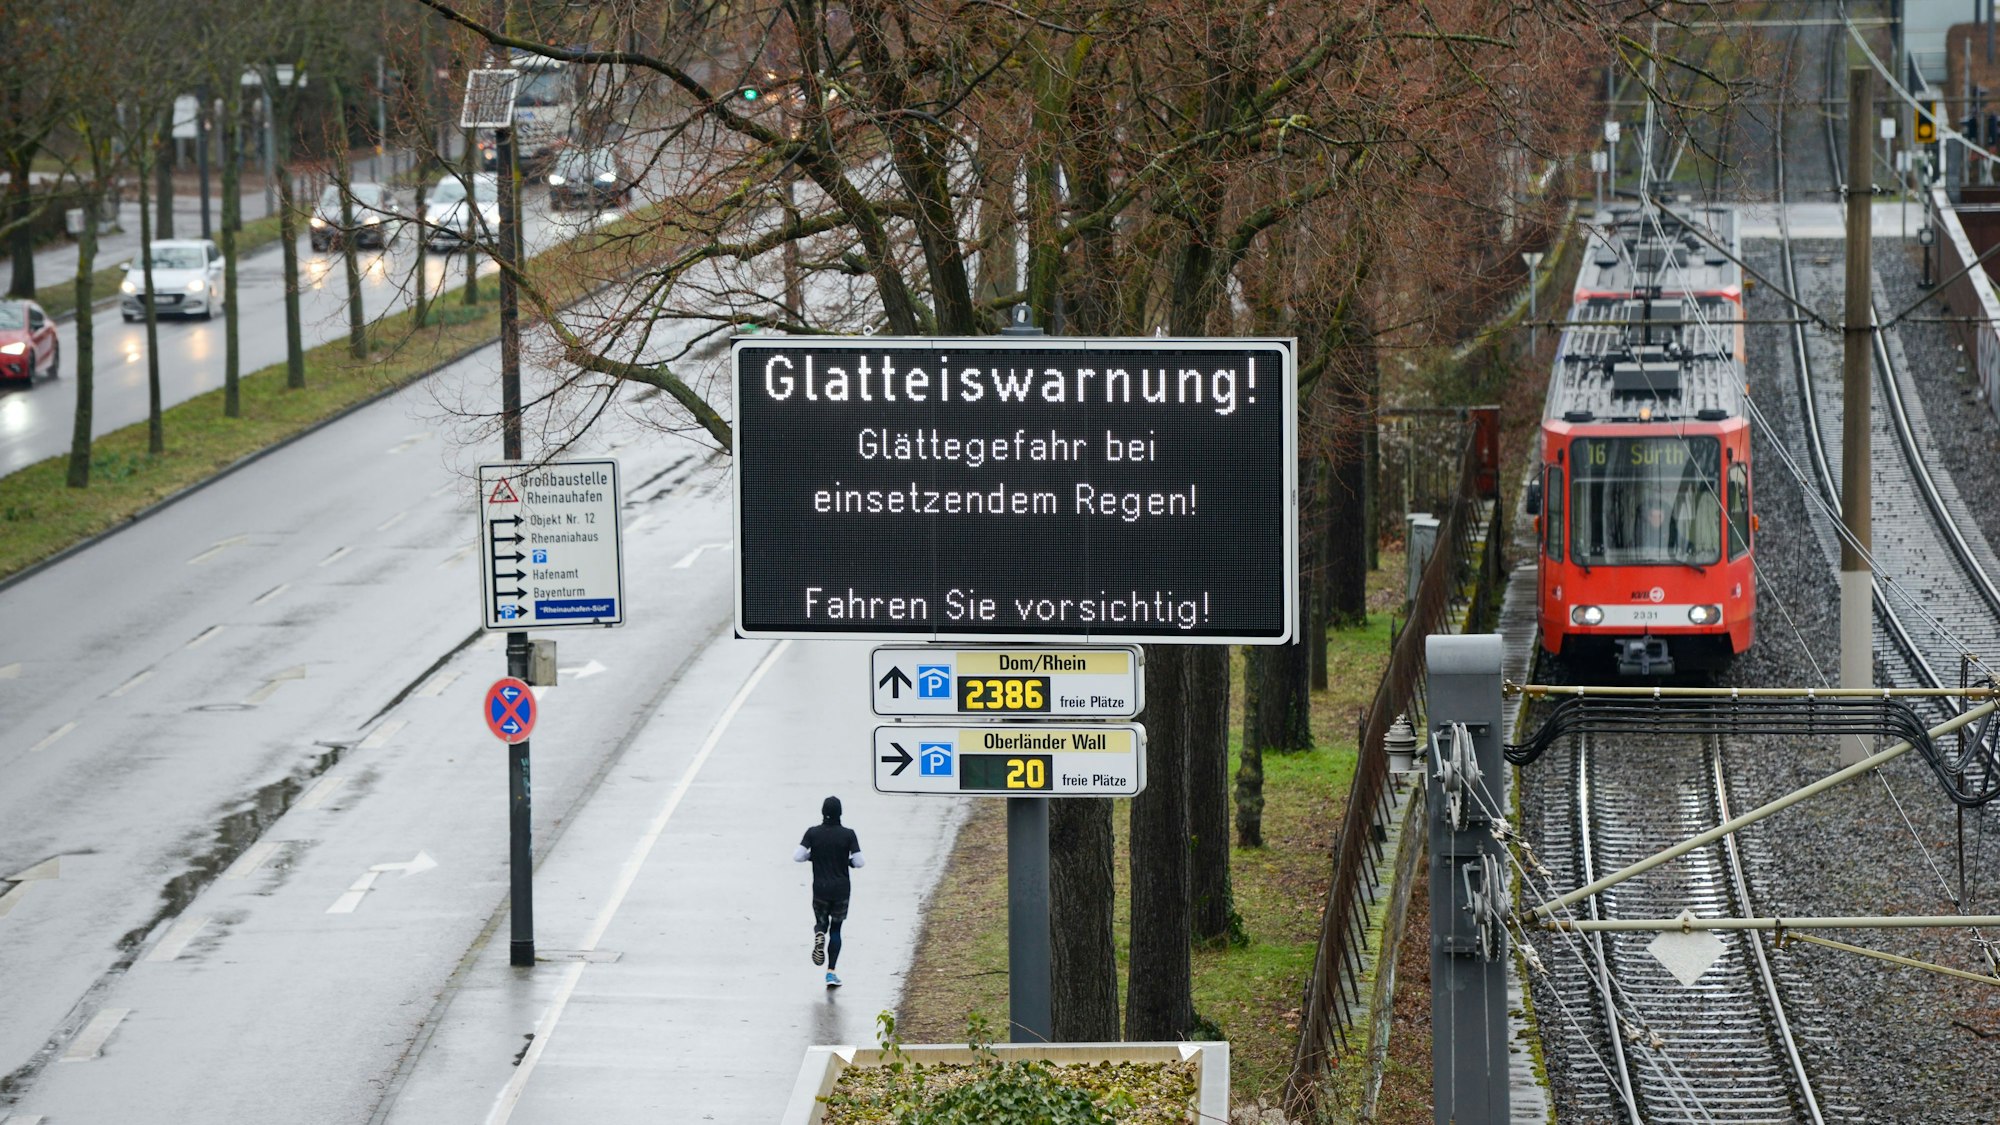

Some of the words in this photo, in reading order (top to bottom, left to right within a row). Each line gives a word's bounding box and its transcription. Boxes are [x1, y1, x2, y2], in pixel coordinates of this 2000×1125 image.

[765, 354, 1257, 416] Glatteiswarnung!
[858, 428, 1087, 467] Glättegefahr
[1106, 430, 1156, 462] bei
[1588, 443, 1606, 465] 16
[520, 471, 608, 488] Großbaustelle
[527, 490, 603, 504] Rheinauhafen
[814, 481, 1057, 515] einsetzendem
[1076, 484, 1197, 523] Regen!
[530, 514, 561, 528] Objekt
[566, 514, 580, 525] Nr.
[585, 513, 596, 524] 12
[531, 532, 599, 544] Rhenaniahaus
[533, 568, 579, 580] Hafenamt
[533, 587, 586, 601] Bayenturm
[806, 587, 927, 621] Fahren
[946, 588, 996, 621] Sie
[1015, 590, 1209, 630] vorsichtig!
[1633, 611, 1658, 620] 2331
[999, 654, 1086, 673] Dom/Rhein
[966, 679, 1043, 709] 2386
[1060, 695, 1086, 708] freie
[1090, 695, 1124, 709] Plätze
[984, 733, 1067, 750] Oberländer
[1072, 733, 1107, 750] Wall
[1006, 759, 1045, 788] 20
[1062, 773, 1088, 787] freie
[1092, 773, 1127, 787] Plätze
